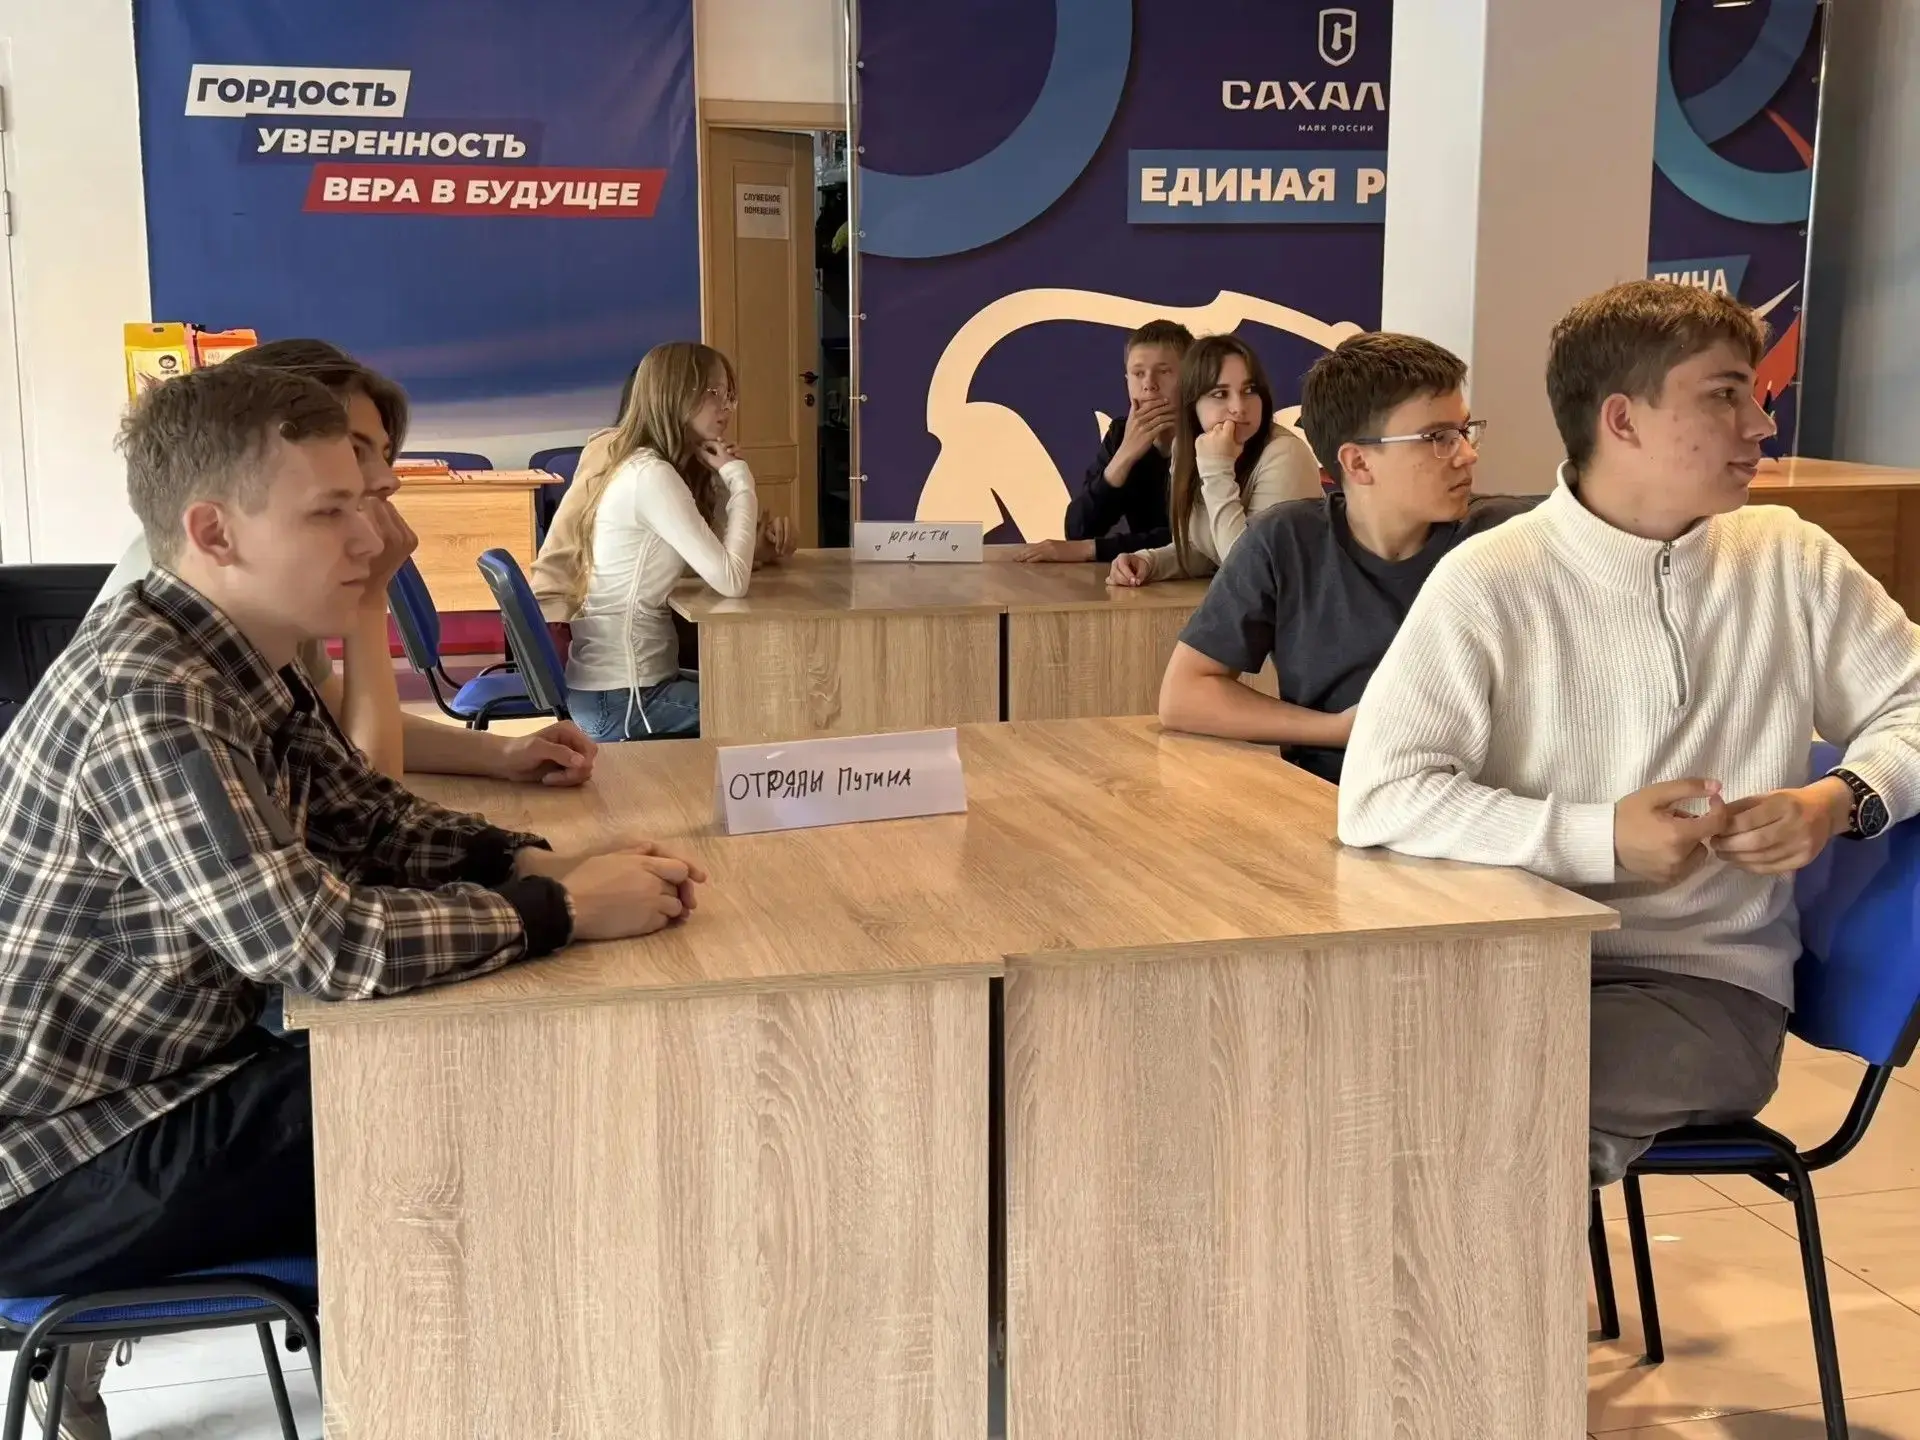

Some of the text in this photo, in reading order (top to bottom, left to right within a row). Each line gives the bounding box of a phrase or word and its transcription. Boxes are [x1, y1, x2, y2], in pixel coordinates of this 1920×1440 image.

[197, 77, 397, 109] ГОРДОСТЬ
[257, 127, 527, 159] УВЕРЕННОСТЬ
[1298, 124, 1374, 132] МАЯК РОССИИ
[323, 176, 642, 211] ВЕРА В БУДУЩЕЕ
[1141, 167, 1336, 206] ЕДИНАЯ
